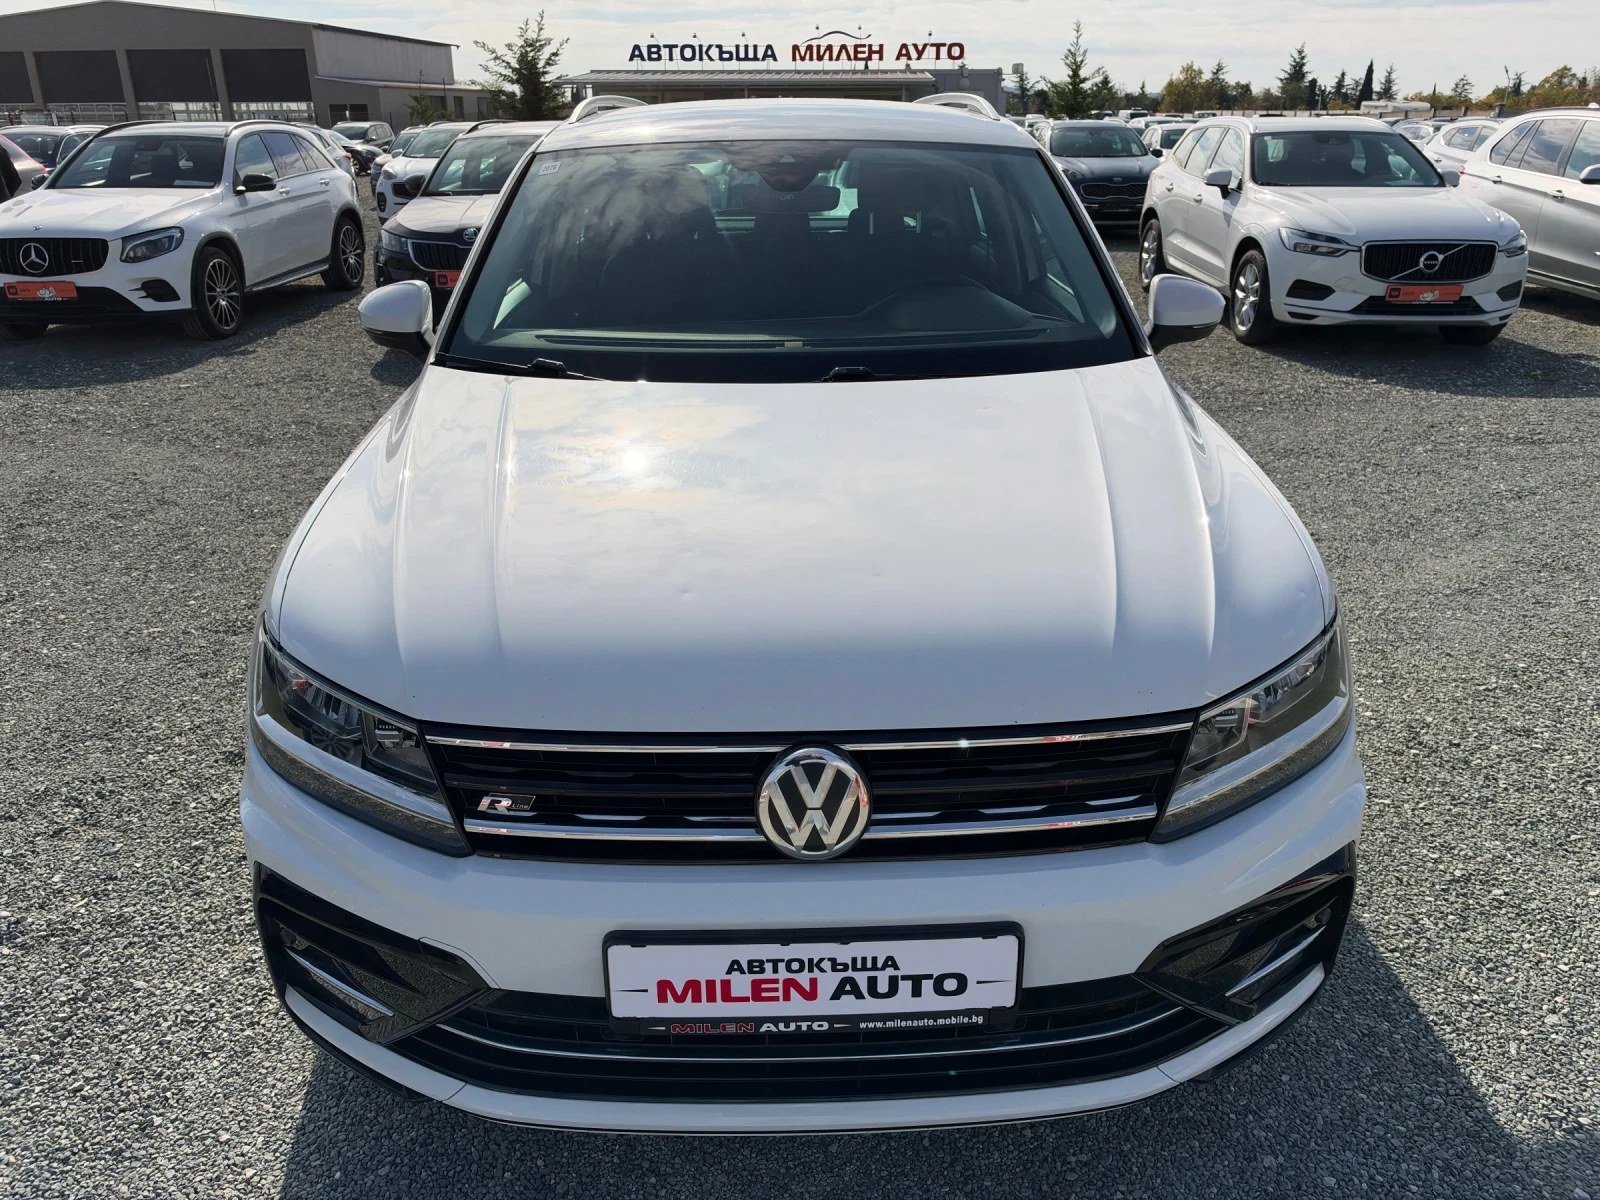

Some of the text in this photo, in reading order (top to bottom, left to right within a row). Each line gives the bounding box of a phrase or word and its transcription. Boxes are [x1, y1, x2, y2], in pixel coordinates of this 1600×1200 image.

[628, 42, 965, 62] АВТОКЪЩА МИЛЕН АУТО
[656, 973, 968, 1004] MILEN AUTO
[671, 1015, 984, 1033] MILEN AUTO www.milenauto.mobile.bg
